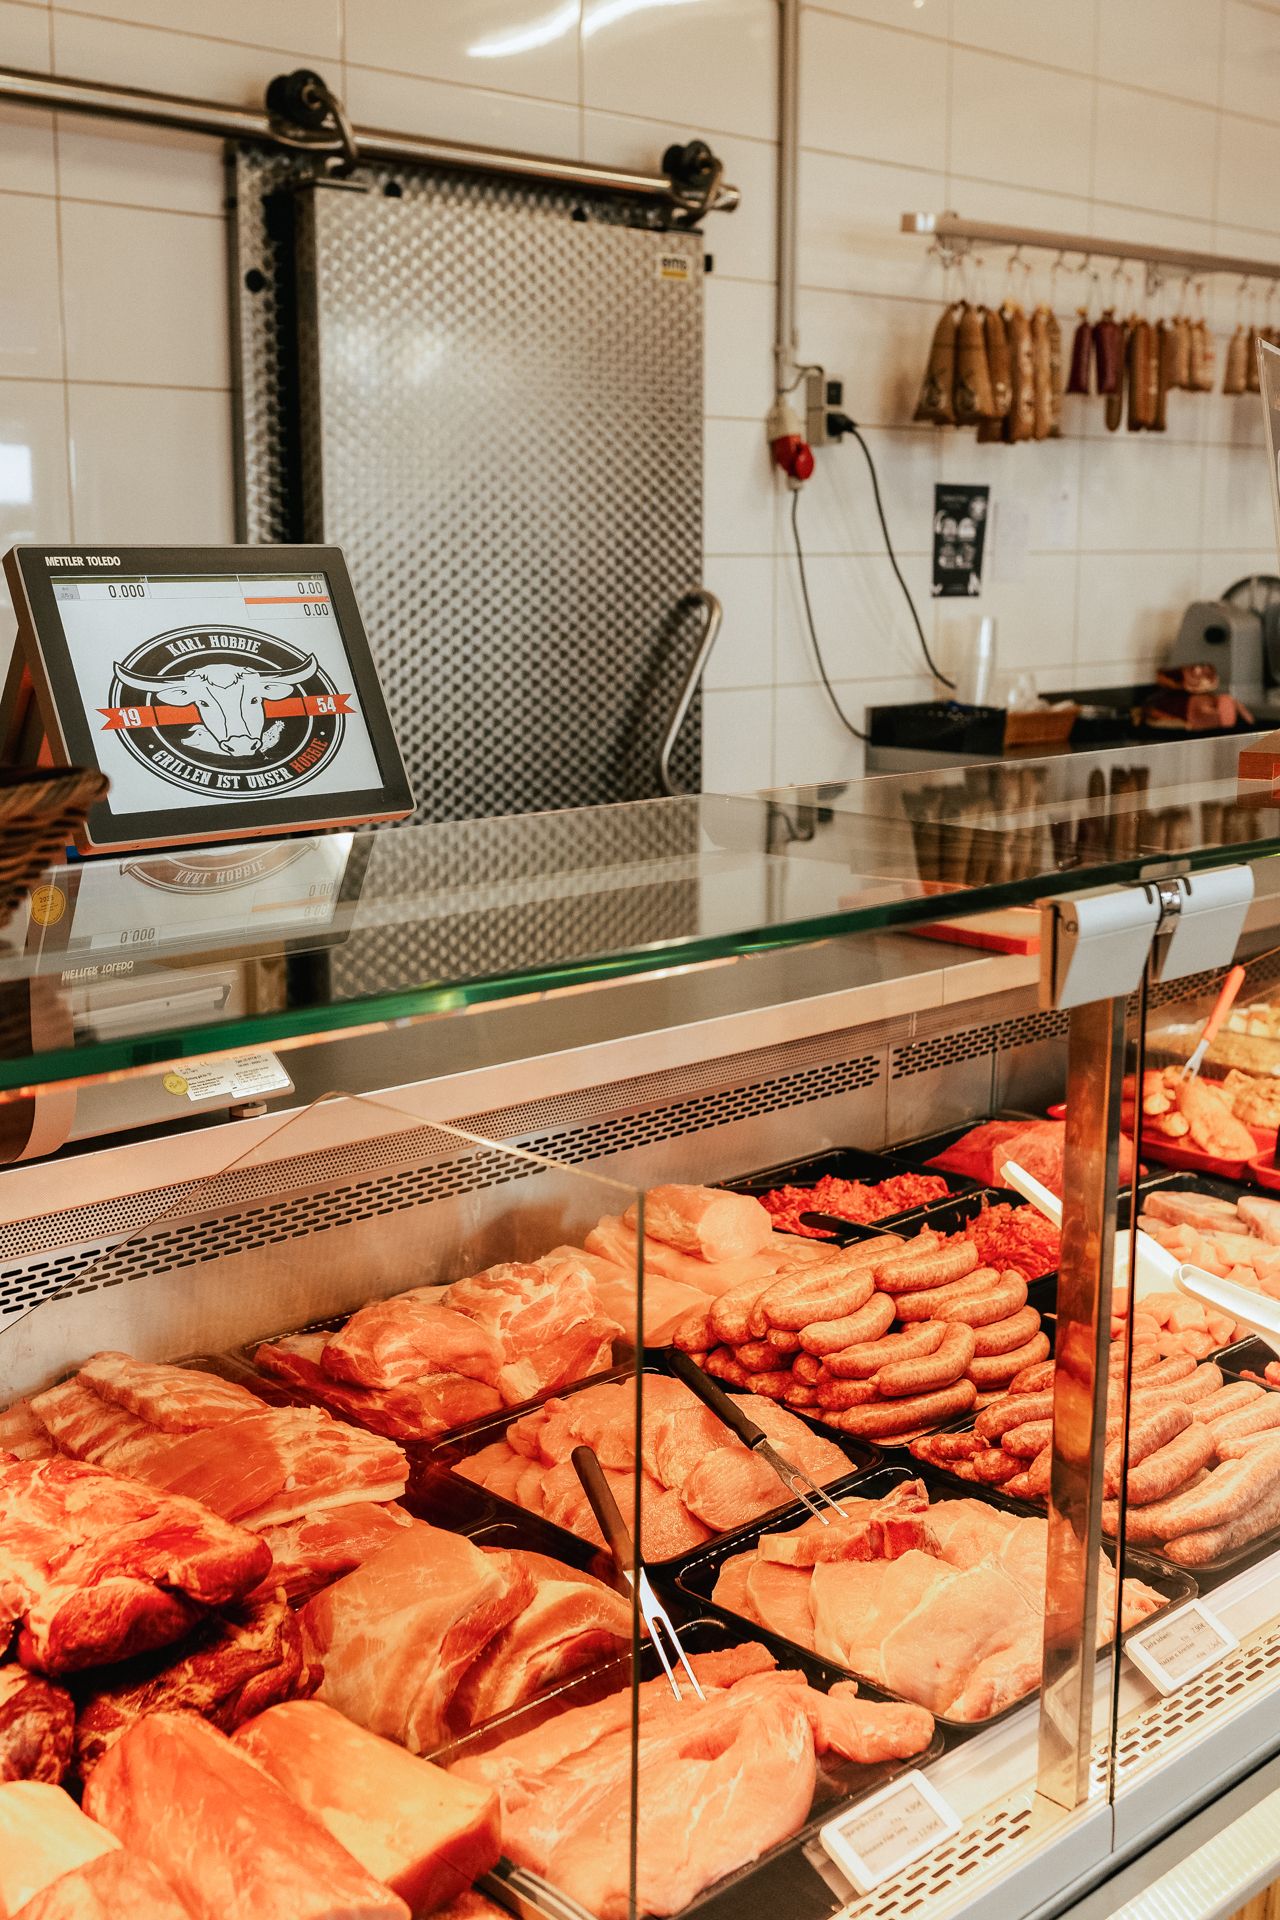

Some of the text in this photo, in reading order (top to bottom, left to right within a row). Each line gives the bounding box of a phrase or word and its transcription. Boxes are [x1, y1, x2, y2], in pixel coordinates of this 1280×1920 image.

[45, 556, 121, 566] METTLER TOLEDO
[108, 584, 145, 599] 0.000
[297, 581, 323, 595] 0.00
[303, 603, 329, 617] 0.00
[165, 635, 262, 657] KARL HOBBIE
[316, 697, 337, 713] 54
[118, 708, 142, 727] 19
[151, 737, 329, 790] GRILLEN IST UNSER HOBBIE
